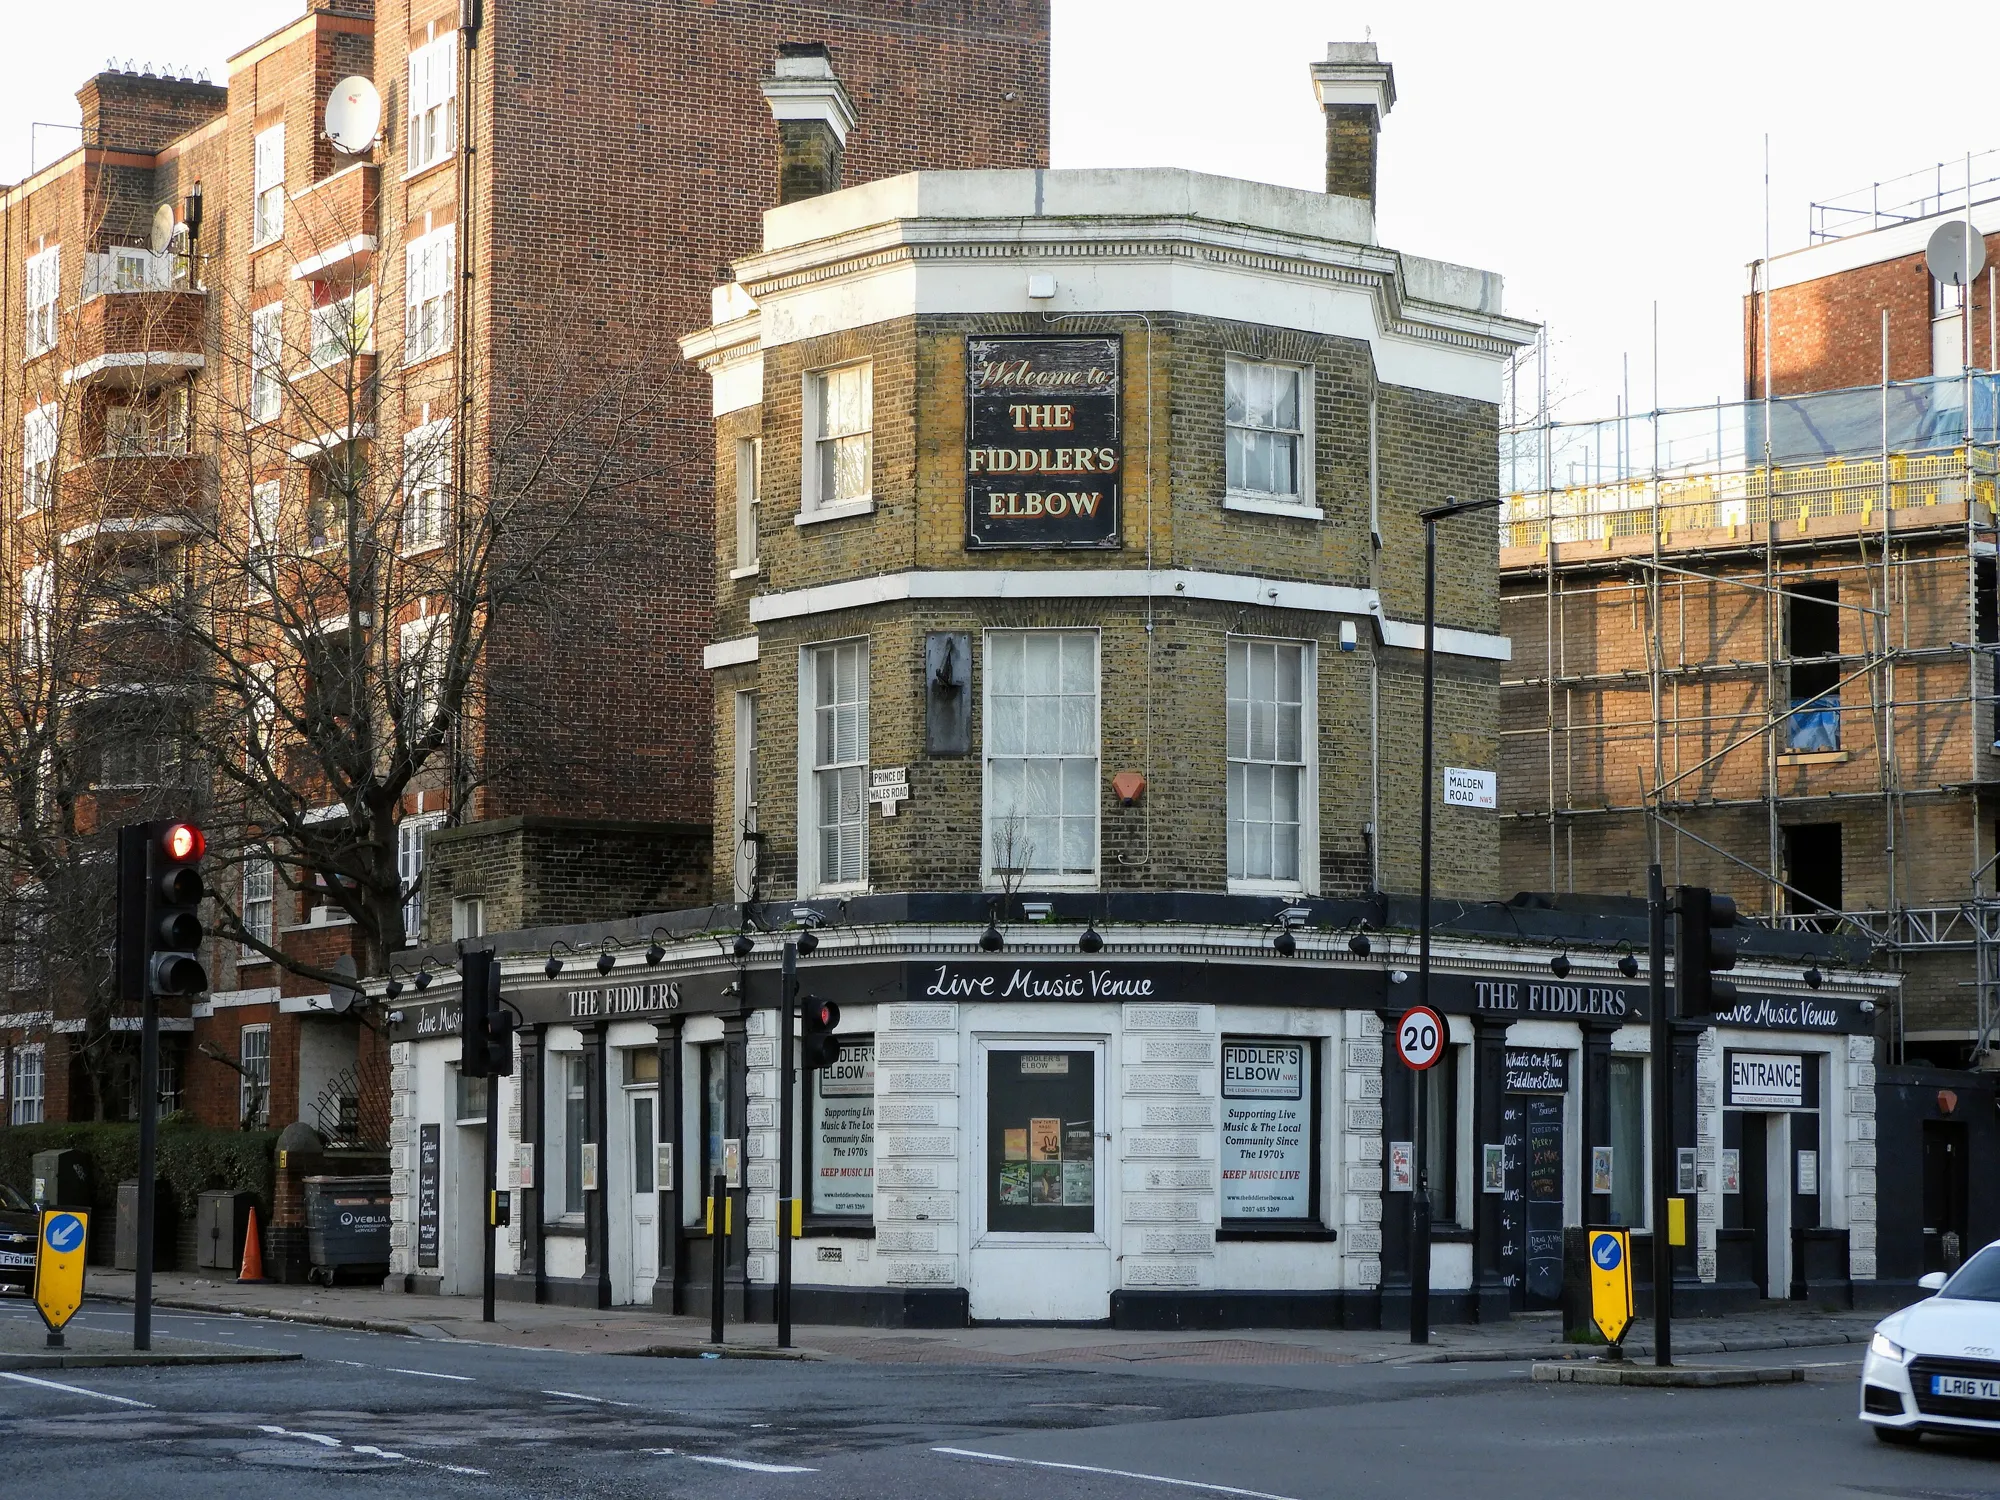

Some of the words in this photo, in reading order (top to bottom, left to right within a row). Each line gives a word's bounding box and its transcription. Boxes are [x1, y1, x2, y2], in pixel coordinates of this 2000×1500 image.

[978, 359, 1082, 387] Welcome
[1087, 366, 1108, 386] to
[1009, 404, 1073, 430] THE
[969, 448, 1116, 473] FIDDLER'S
[988, 492, 1101, 517] ELBOW
[874, 771, 895, 783] PRINCE
[897, 770, 904, 780] OF
[1450, 776, 1483, 790] MALDEN
[870, 788, 890, 800] WALES
[891, 786, 907, 798] ROAD
[1450, 790, 1474, 802] ROAD
[1480, 796, 1492, 804] NW5
[927, 964, 995, 997] Live
[1000, 968, 1084, 997] Music
[1089, 969, 1154, 997] Venue
[568, 989, 598, 1017] THE
[605, 982, 679, 1014] FIDDLERS
[1475, 981, 1519, 1010] THE
[1528, 984, 1626, 1016] FIDDLERS
[417, 1006, 436, 1034] Live
[1754, 999, 1798, 1027] Music
[1801, 1000, 1839, 1026] Venue
[1404, 1025, 1436, 1051] 20
[839, 1047, 874, 1062] DLER'
[1226, 1049, 1298, 1065] FIDDLER'S
[1505, 1052, 1529, 1069] What's
[1531, 1053, 1541, 1067] On
[1551, 1053, 1563, 1067] The
[823, 1065, 864, 1079] ELBOW
[1226, 1066, 1280, 1080] ELBOW
[1732, 1062, 1801, 1087] ENTRANCE
[1506, 1071, 1542, 1089] Fiddlers
[1542, 1071, 1563, 1089] Elbow
[825, 1108, 861, 1119] Supporting
[862, 1107, 874, 1116] Liv
[1228, 1109, 1276, 1121] Supporting
[1278, 1110, 1296, 1119] Live
[1504, 1110, 1516, 1120] on
[820, 1121, 840, 1130] Music
[841, 1121, 847, 1130] &
[849, 1121, 861, 1130] The
[862, 1121, 874, 1130] Loc
[1223, 1122, 1248, 1132] Music
[1251, 1122, 1258, 1131] &
[1260, 1122, 1276, 1132] The
[1277, 1123, 1301, 1132] Local
[823, 1134, 860, 1146] Community
[861, 1134, 874, 1143] Sinc
[1225, 1136, 1275, 1148] Community
[1276, 1136, 1299, 1146] Since
[1531, 1137, 1553, 1150] MERRY
[833, 1147, 846, 1157] The
[847, 1147, 868, 1157] 1970's
[1240, 1149, 1256, 1159] The
[1258, 1149, 1285, 1159] 1970's
[820, 1168, 839, 1177] KEEP
[840, 1168, 863, 1177] MUSIC
[1222, 1170, 1247, 1179] KEEP
[1249, 1170, 1278, 1180] MUSIC
[1279, 1170, 1301, 1180] LIVE
[1503, 1240, 1512, 1256] at
[4, 1255, 22, 1264] FY61
[1943, 1380, 1976, 1395] LR16
[1980, 1382, 2000, 1397] YL
